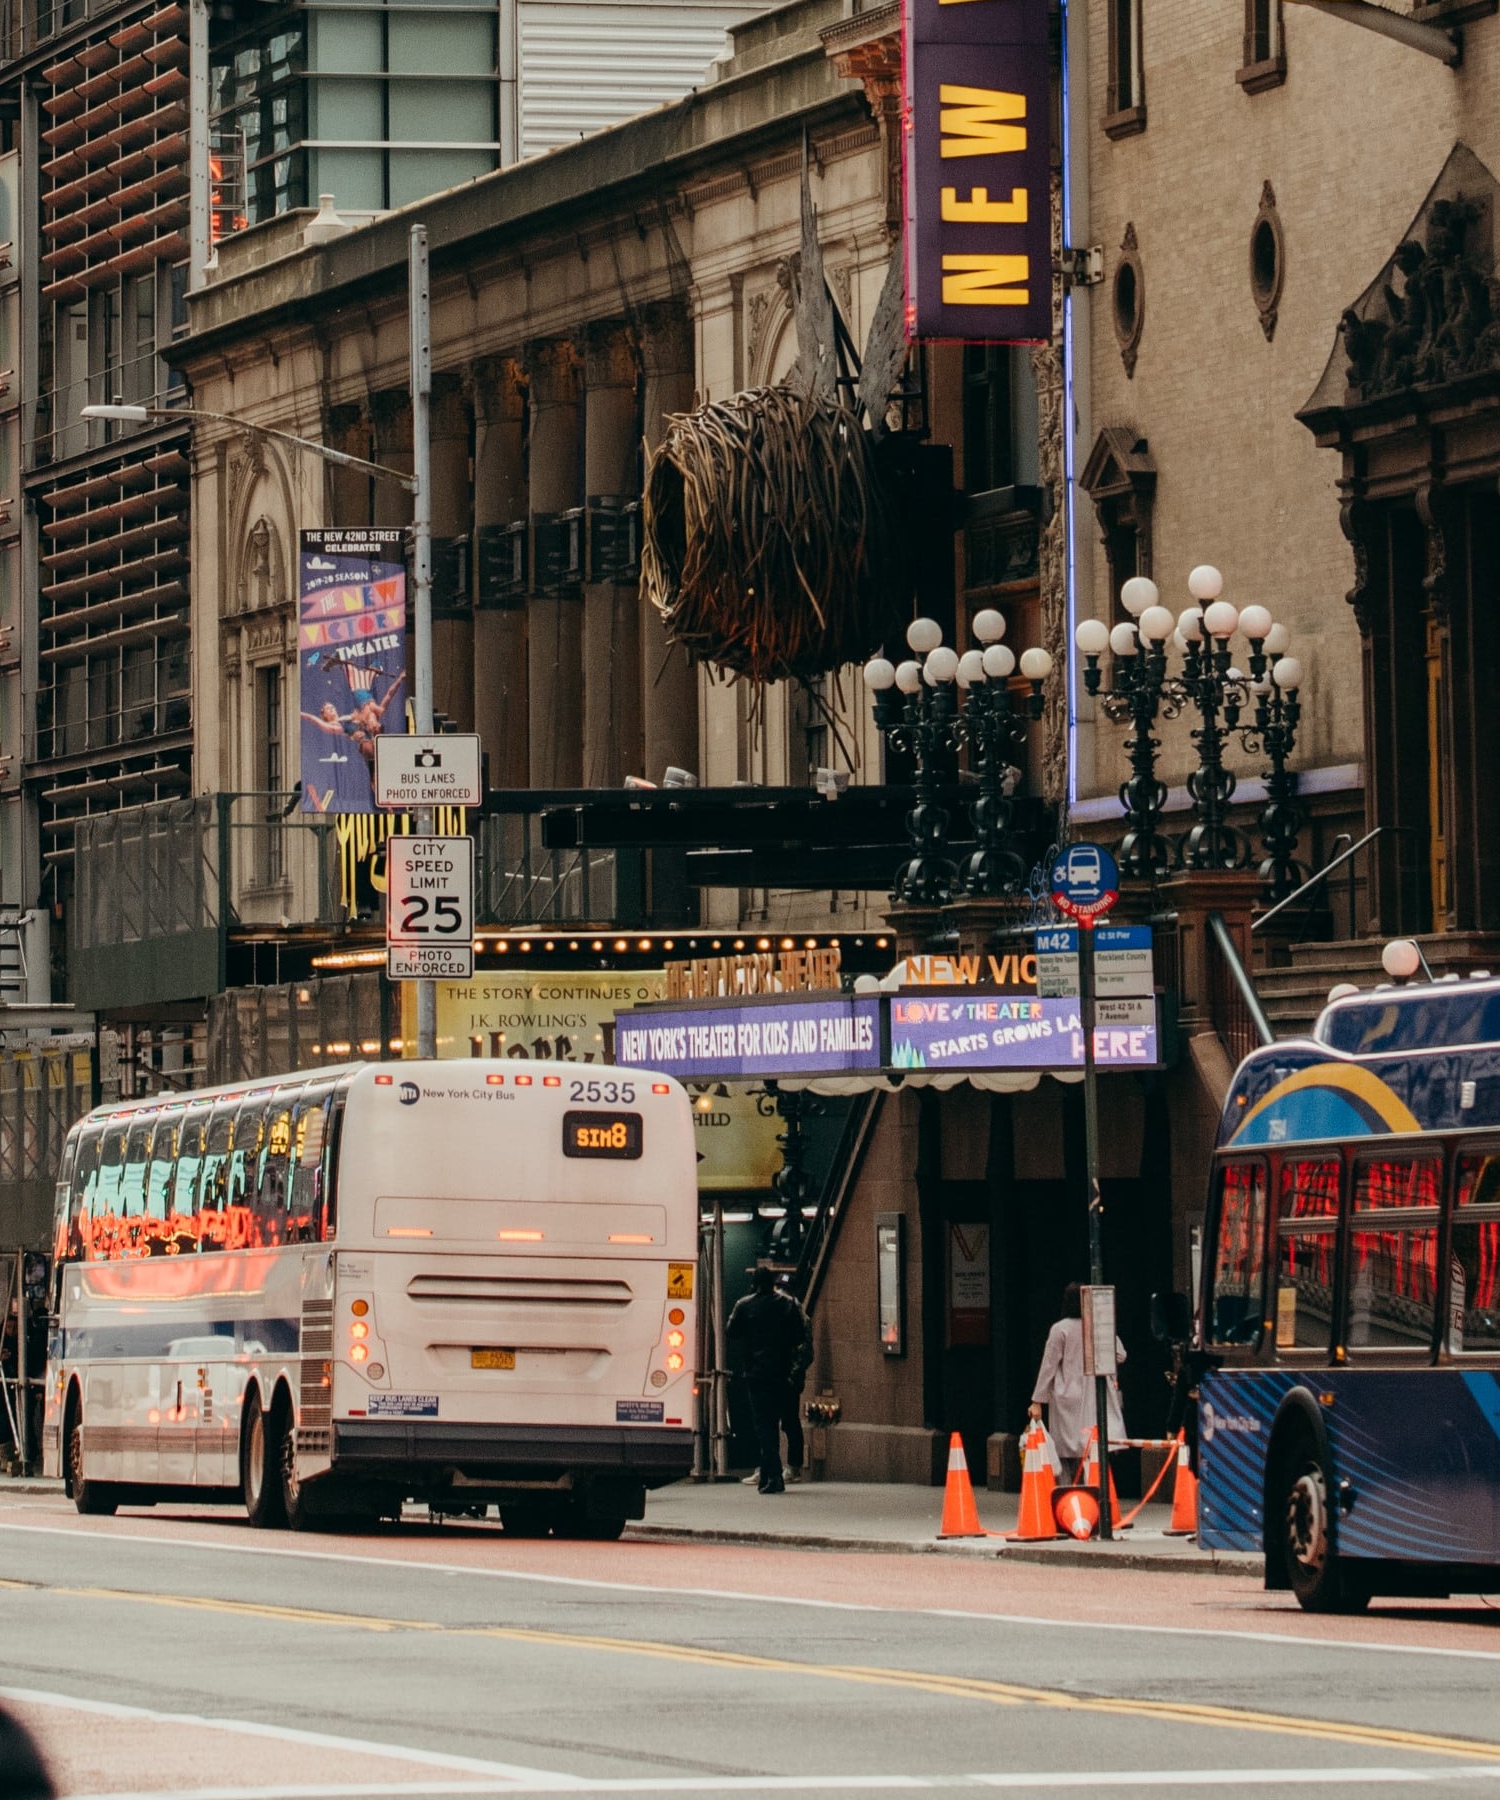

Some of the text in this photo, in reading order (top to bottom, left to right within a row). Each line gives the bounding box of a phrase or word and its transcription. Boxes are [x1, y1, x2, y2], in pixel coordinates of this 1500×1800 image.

[939, 83, 1031, 306] NEW
[306, 530, 400, 542] THE NEW 42ND STREET
[325, 544, 381, 552] CELEBRATES
[335, 571, 369, 583] SEASON
[319, 580, 398, 615] THE NEW
[304, 610, 400, 645] VICTORY
[337, 634, 400, 662] THEATER
[401, 773, 455, 784] BUS LANES
[386, 788, 471, 799] PHOTO ENFORCED
[412, 843, 446, 855] CITY
[405, 860, 453, 872] SPEED
[410, 877, 449, 889] LIMIT
[1057, 894, 1114, 914] NO STANDING
[400, 895, 462, 934] 25
[1038, 933, 1071, 950] M42
[409, 951, 452, 960] PHOTO
[395, 962, 465, 973] ENFORCED
[905, 955, 980, 985] NEW
[447, 988, 661, 1000] THE STORY CONTINUES ON
[895, 1001, 1042, 1024] LOVE THEATER
[470, 1014, 587, 1028] J.K. ROWLING'S
[622, 1029, 649, 1061] NEW
[649, 1026, 688, 1061] YORK'S
[688, 1024, 736, 1059] THEATER
[738, 1023, 761, 1057] FOR
[762, 1021, 789, 1056] KIDS
[791, 1019, 818, 1054] AND
[820, 1015, 874, 1053] FAMILIES
[929, 1014, 1082, 1059] STARTS GROWS LA
[422, 1089, 515, 1101] New York City Bus
[569, 1081, 636, 1104] 2535
[576, 1121, 628, 1148] SIM8
